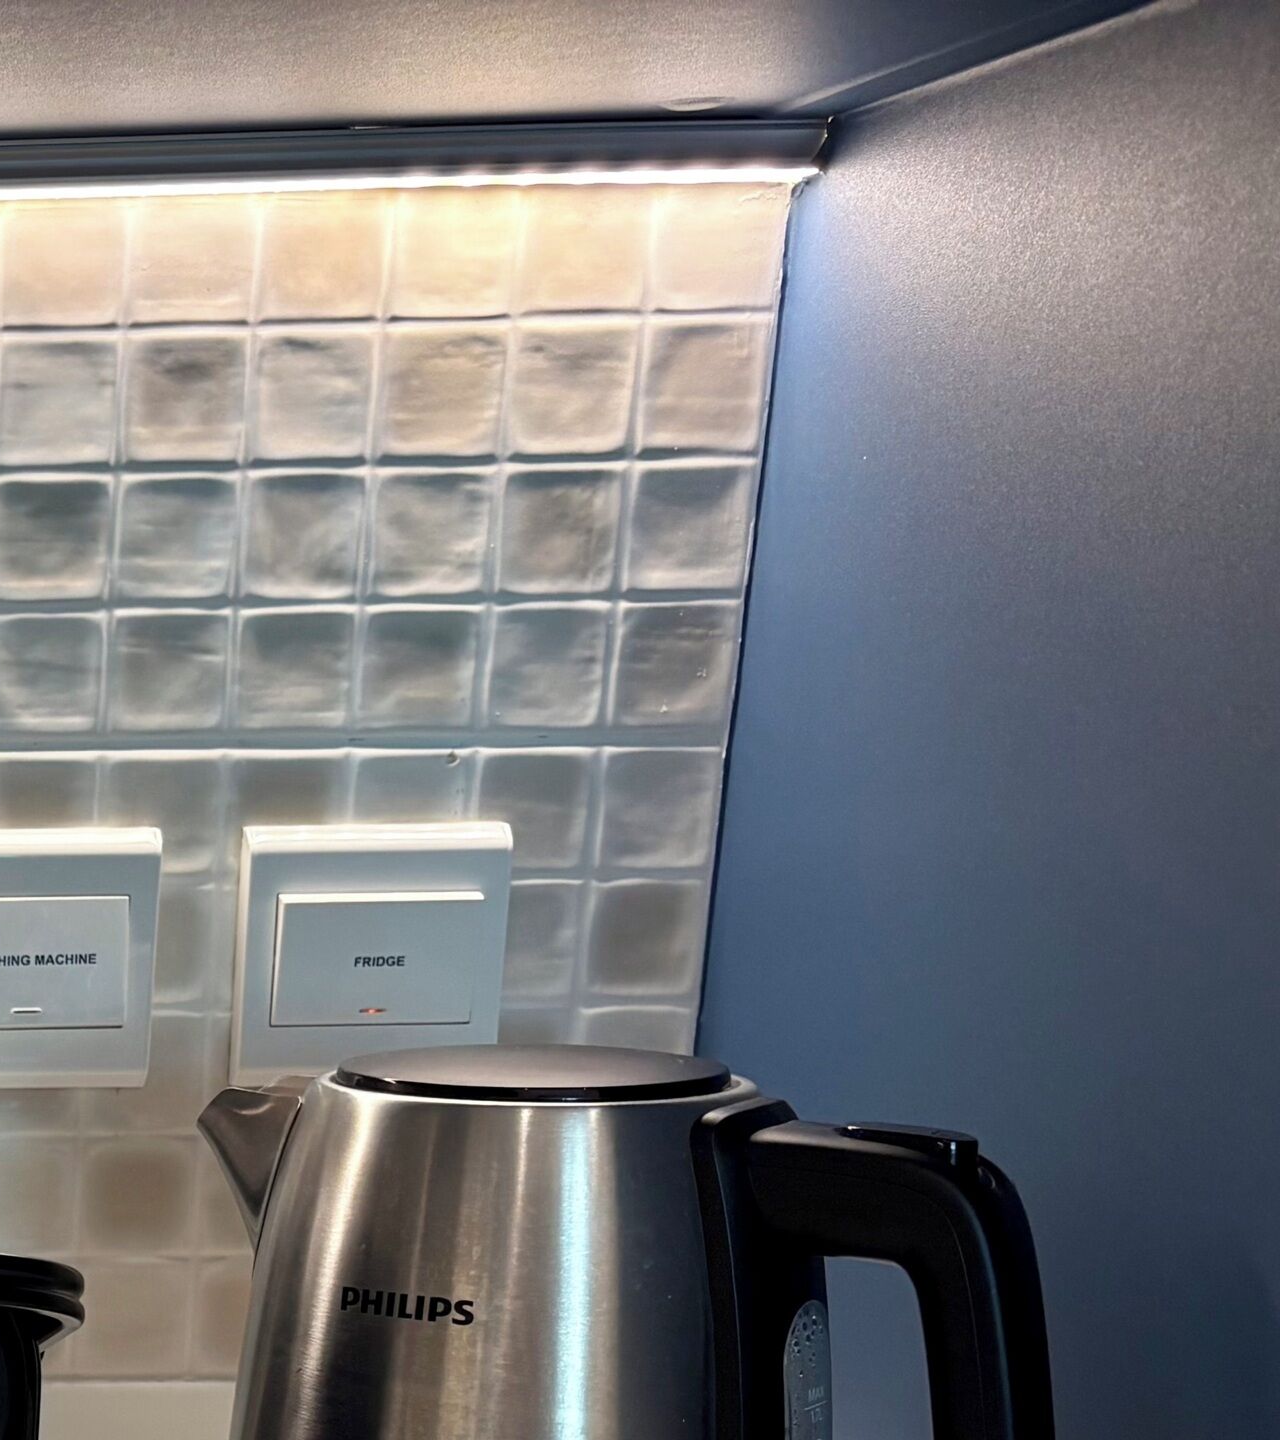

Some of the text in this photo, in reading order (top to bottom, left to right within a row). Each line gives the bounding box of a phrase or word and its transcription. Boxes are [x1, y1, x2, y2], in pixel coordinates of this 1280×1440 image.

[34, 951, 98, 967] MACHINE
[353, 953, 406, 970] FRIDGE
[340, 1284, 476, 1327] PHILIPS
